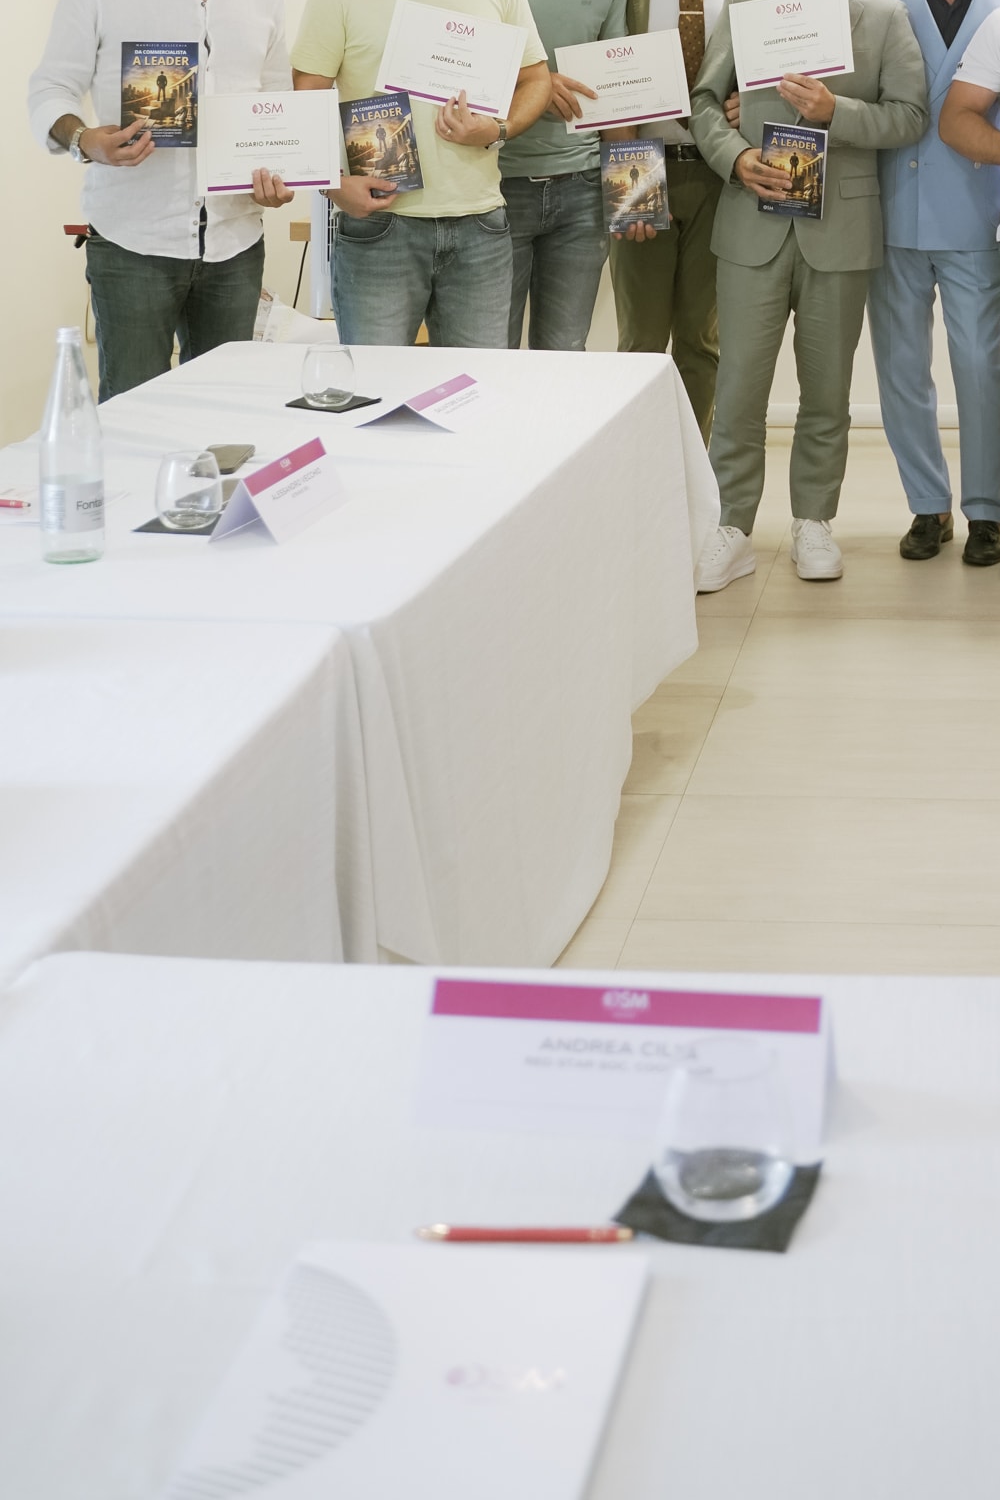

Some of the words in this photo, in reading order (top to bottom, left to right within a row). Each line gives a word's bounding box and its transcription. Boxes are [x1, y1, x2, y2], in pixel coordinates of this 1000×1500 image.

[776, 2, 803, 15] OSM
[445, 21, 475, 37] OSM
[763, 37, 787, 46] GIUSEPPE
[788, 32, 819, 42] MANGIONE
[606, 46, 634, 59] OSM
[132, 56, 141, 66] A
[144, 56, 189, 66] LEADER
[430, 54, 455, 65] ANDREA
[457, 59, 472, 68] CILIA
[596, 81, 621, 91] GIUSEPPE
[252, 102, 284, 114] OSM
[359, 101, 399, 112] COMMERCIALISTA
[351, 114, 359, 124] A
[361, 107, 403, 122] LEADER
[266, 139, 300, 147] PANNUZZO
[771, 137, 778, 146] A
[781, 138, 817, 151] LEADER
[608, 153, 616, 162] A
[618, 150, 656, 161] LEADER
[540, 1036, 633, 1056] ANDREA
